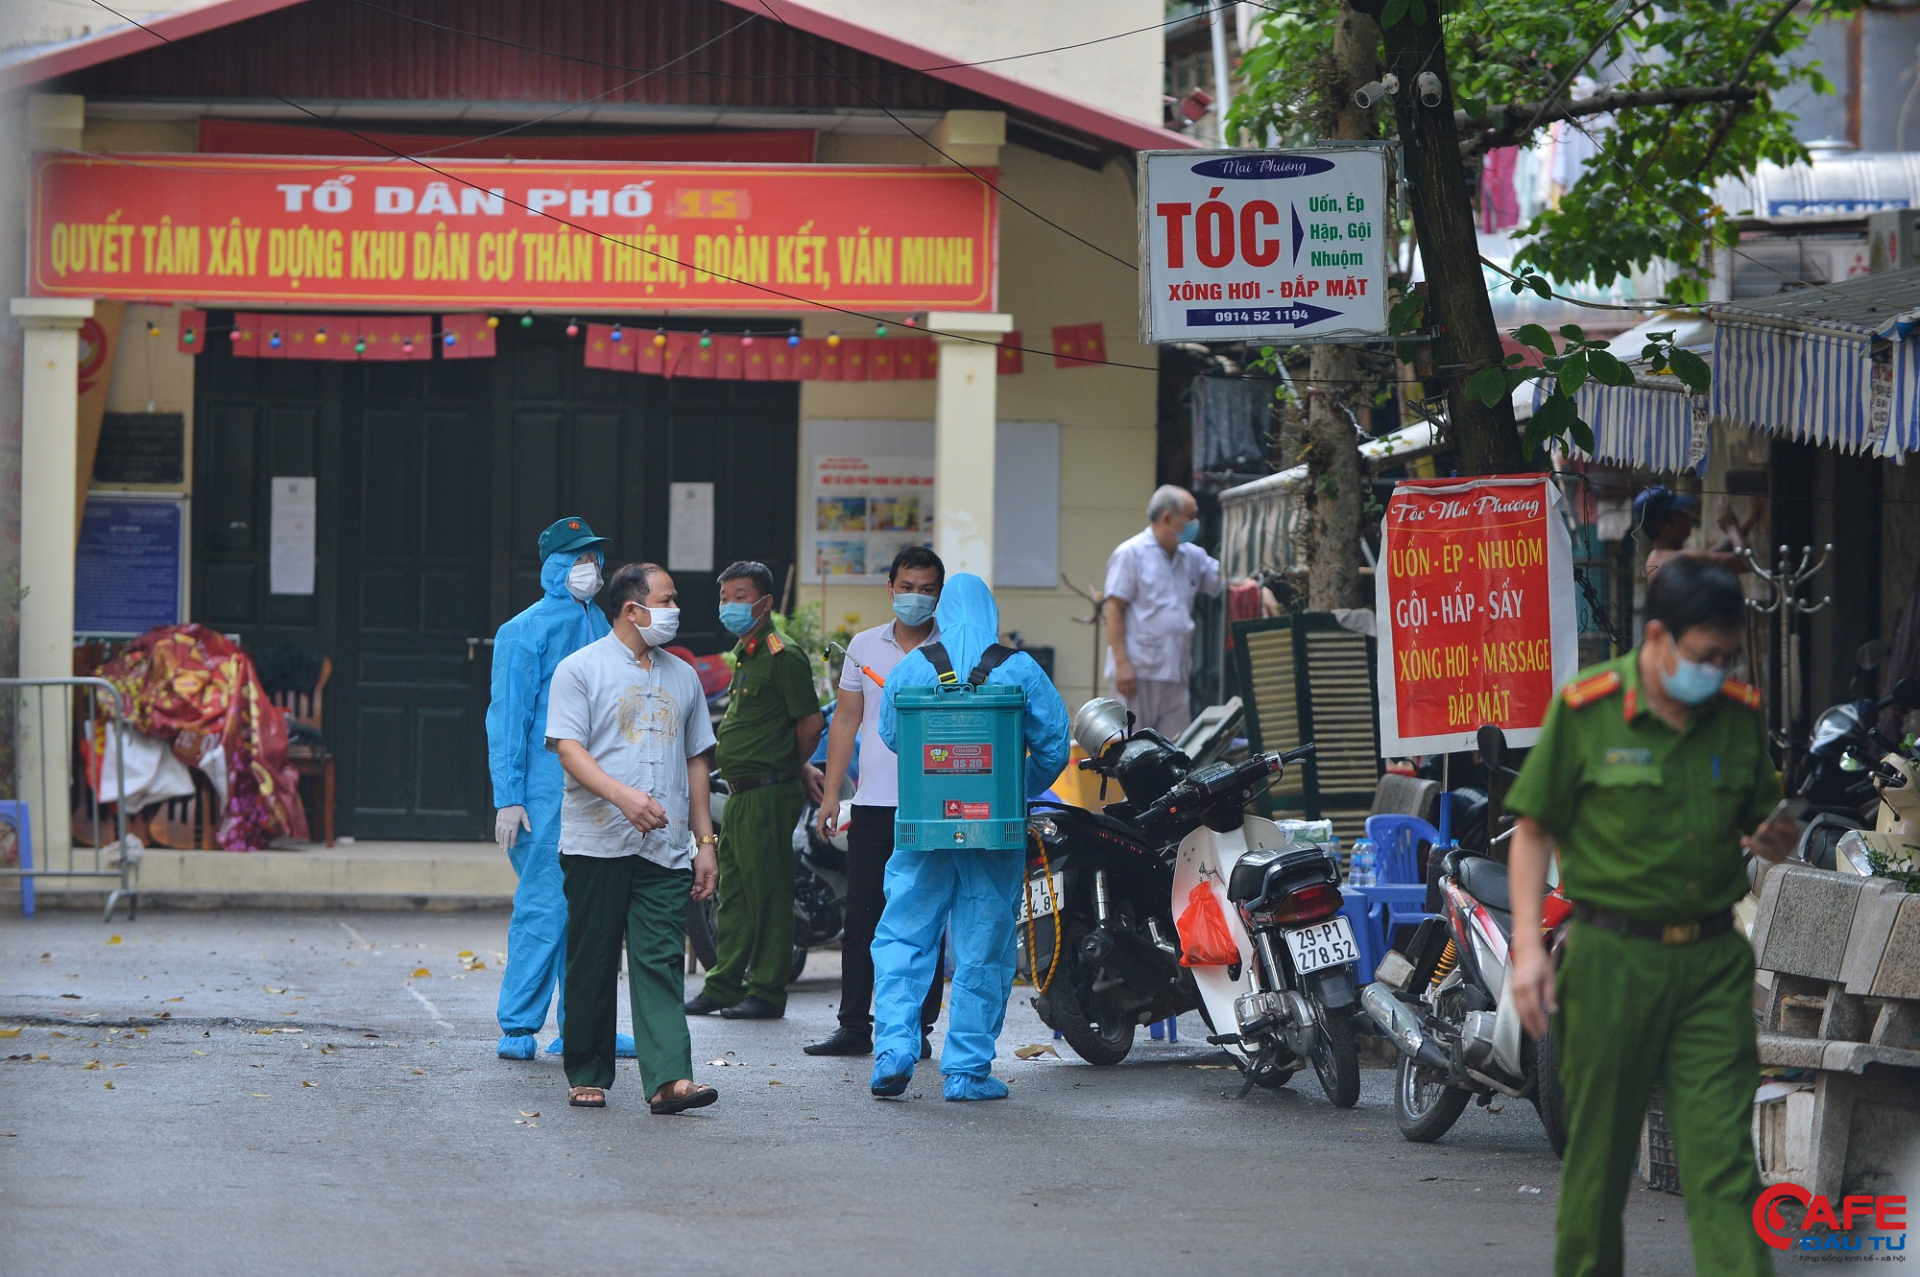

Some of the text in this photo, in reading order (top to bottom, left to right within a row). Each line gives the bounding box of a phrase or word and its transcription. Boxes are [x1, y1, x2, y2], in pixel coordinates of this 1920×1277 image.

[1219, 160, 1252, 176] Mai
[277, 175, 738, 218] TỔ DÂN PHỐ 15
[1309, 192, 1365, 213] Uốn, Ép
[1157, 186, 1280, 269] TÓC
[1310, 222, 1371, 242] Hập, Gội
[51, 209, 974, 293] QUYẾT TÂM XÂY DỰNG KHU DÂN CƯ THÂN THIỆN, ĐOÀN KẾT, VĂN MINH
[1311, 250, 1363, 269] Nhuộm
[1168, 280, 1222, 301] XÔNG
[1228, 281, 1260, 300] HƠI
[1280, 274, 1319, 298] ĐẮP
[1326, 275, 1368, 300] MẶT
[1215, 310, 1309, 322] 0914 52 1194
[1391, 495, 1540, 523] Tóc Mai Phương
[1392, 535, 1430, 578] UỐN
[1443, 537, 1464, 574] ÉP
[1478, 530, 1544, 574] NHUỘM
[1396, 590, 1428, 634] GỘI
[1441, 581, 1475, 624] HẤP
[1489, 577, 1524, 620] SẤY
[1399, 640, 1442, 682] XÔNG
[1446, 643, 1470, 678] HƠI
[1484, 638, 1550, 675] MASSAGE
[1448, 679, 1474, 726] ĐẮP
[970, 759, 982, 768] 20
[1296, 921, 1343, 950] 29-P1
[1297, 940, 1356, 971] 278.52
